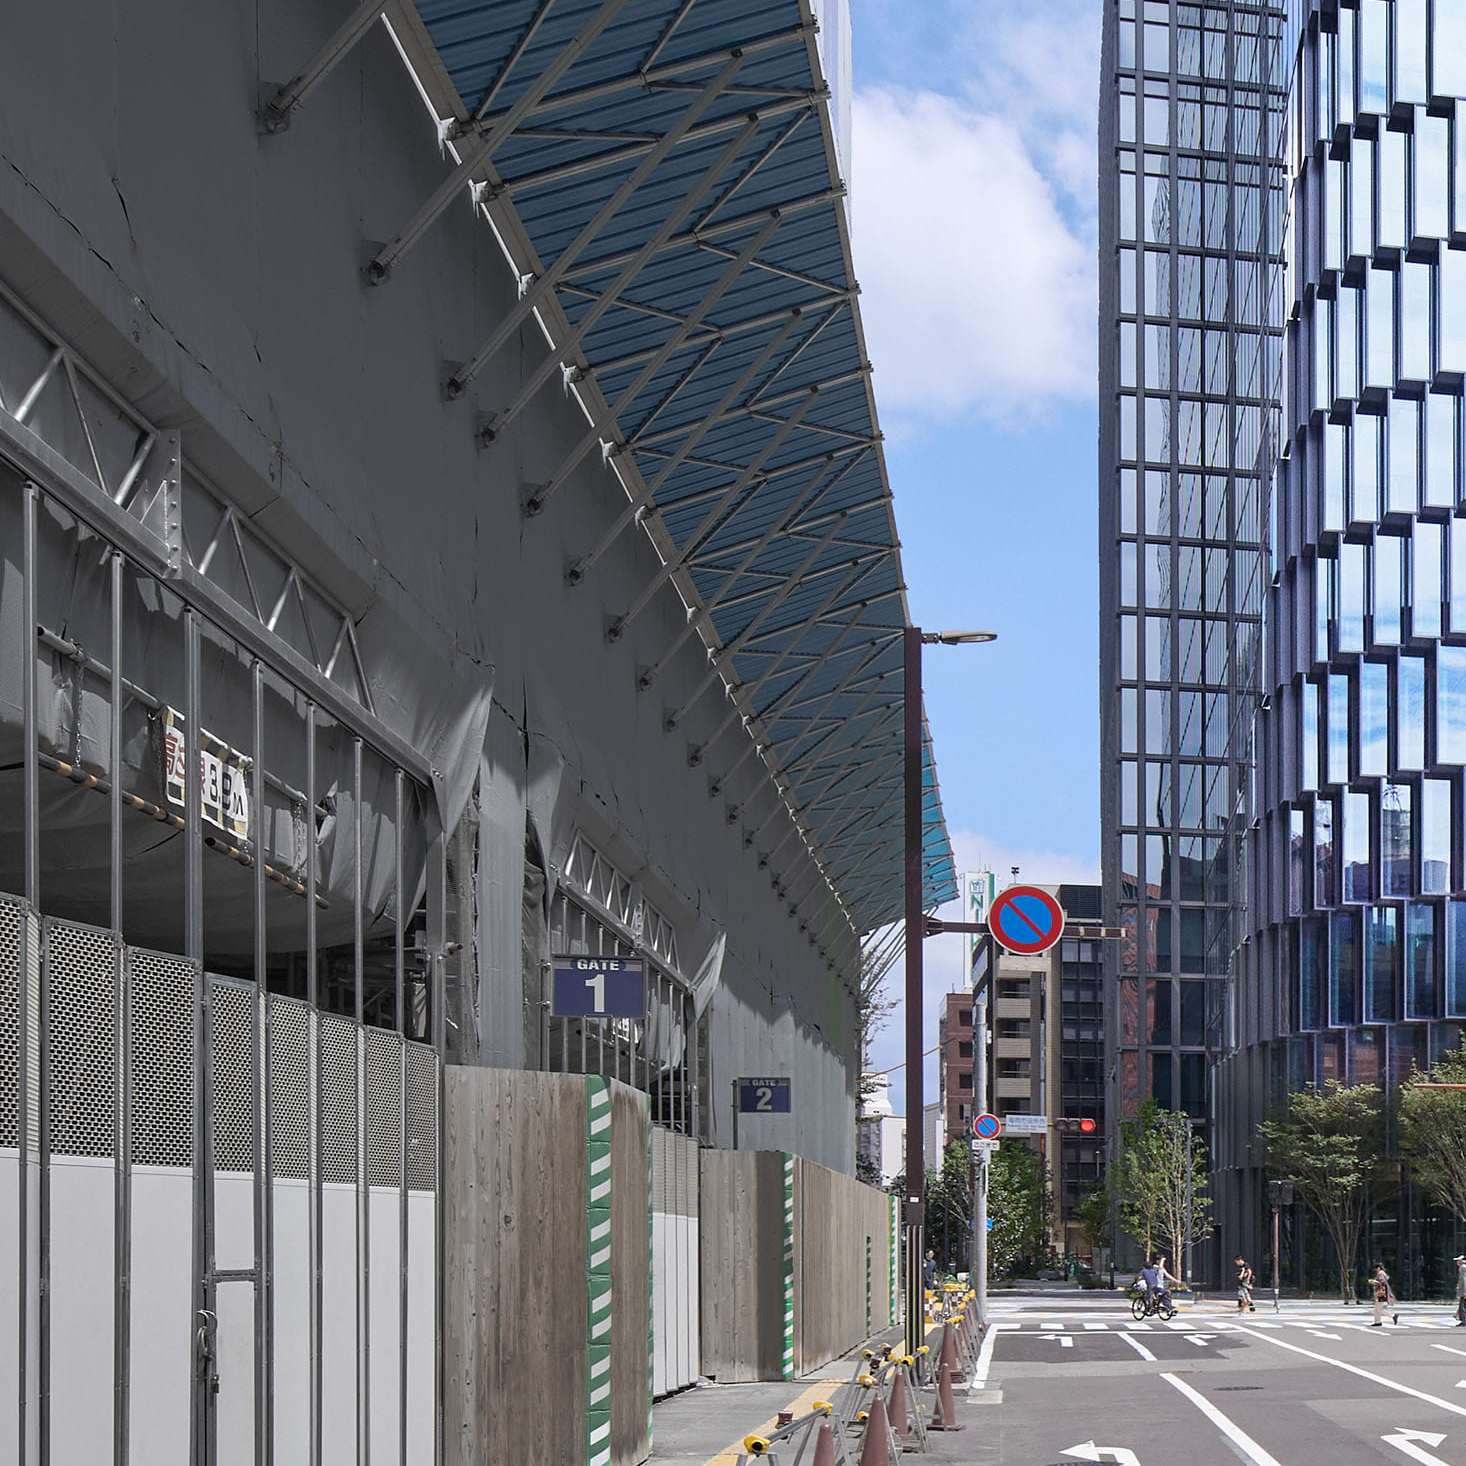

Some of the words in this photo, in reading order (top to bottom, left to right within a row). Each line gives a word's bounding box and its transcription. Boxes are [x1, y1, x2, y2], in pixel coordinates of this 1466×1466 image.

[576, 959, 620, 971] GATE
[585, 974, 605, 1013] 1
[752, 1079, 777, 1087] GATE
[756, 1087, 772, 1111] 2
